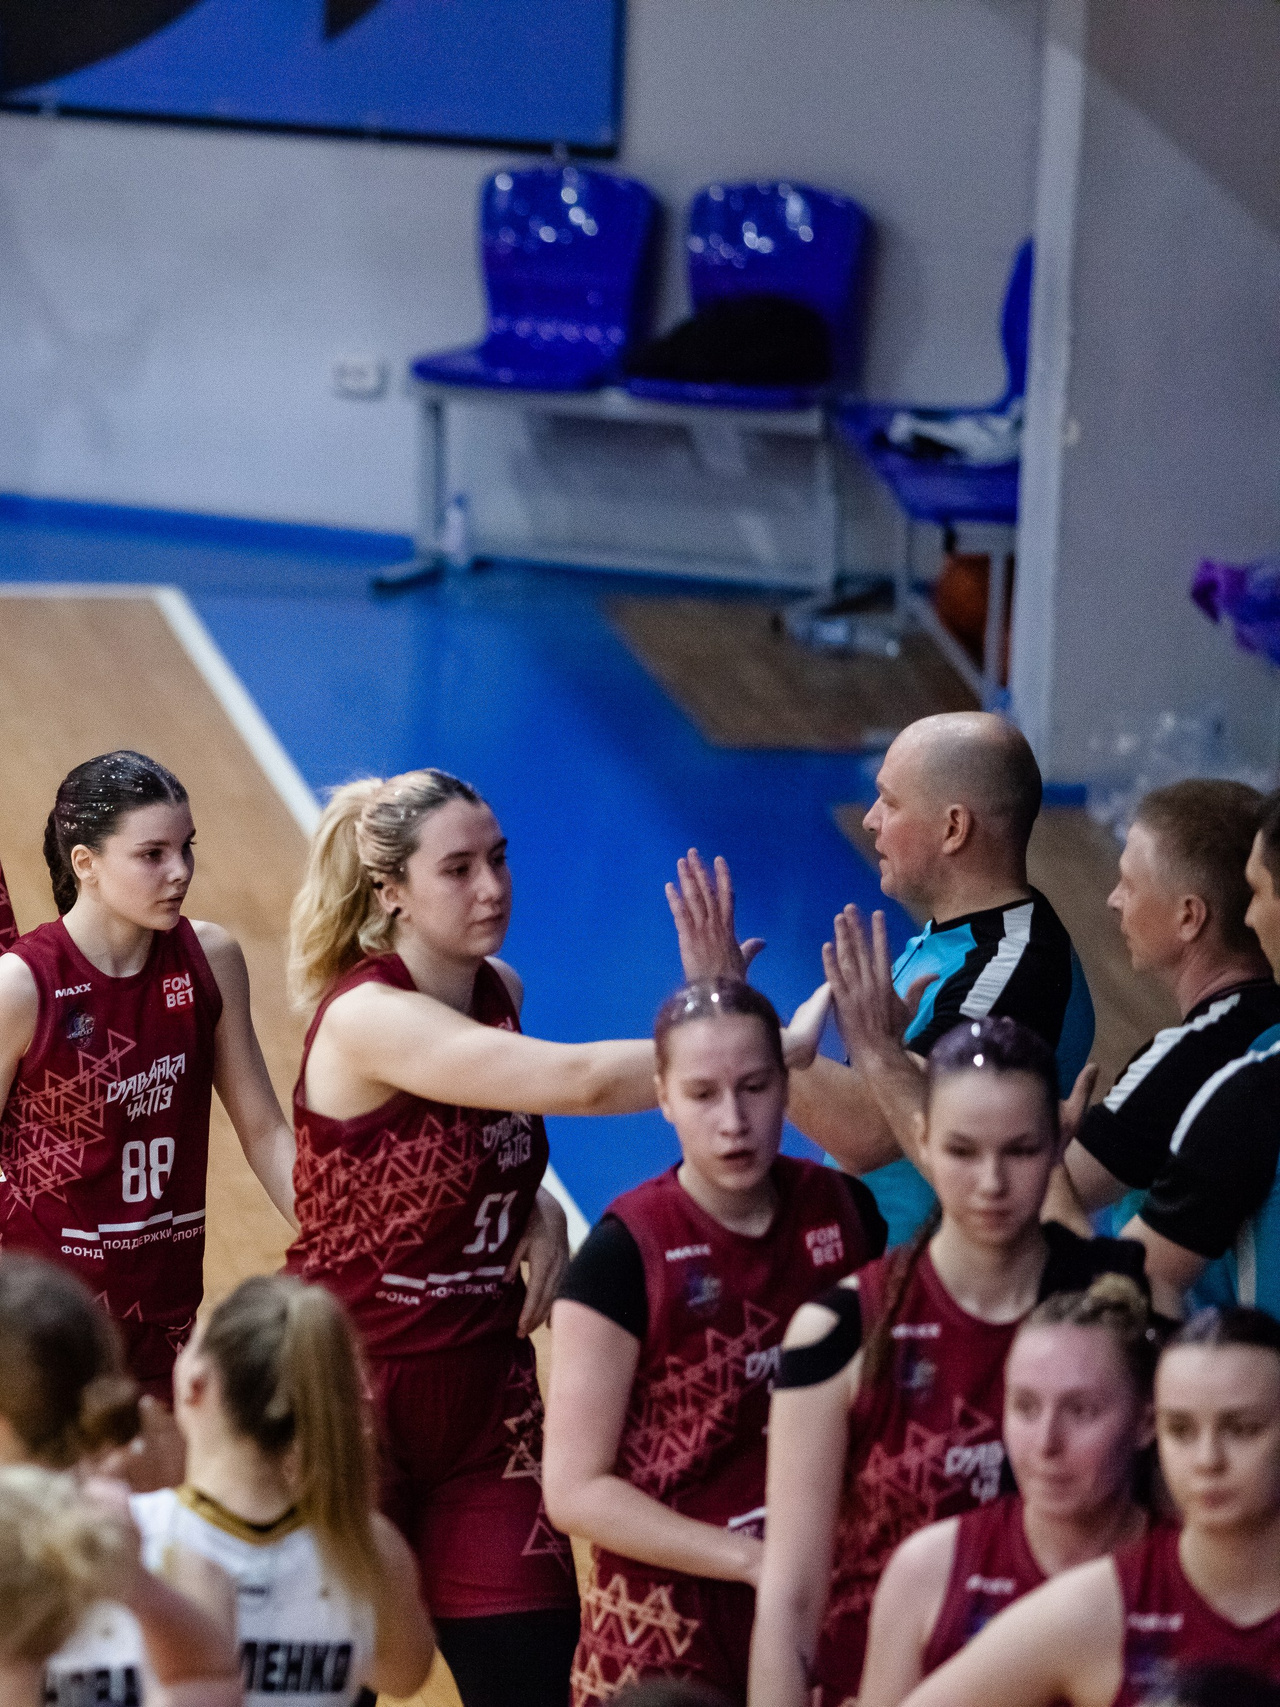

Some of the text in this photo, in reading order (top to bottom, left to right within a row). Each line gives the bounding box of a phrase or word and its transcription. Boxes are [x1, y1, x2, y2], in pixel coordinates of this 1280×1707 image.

[55, 982, 92, 998] MAXX
[163, 973, 191, 992] FON
[166, 987, 194, 1008] BET
[462, 1190, 518, 1254] 51
[61, 1244, 104, 1260] ФОНД
[103, 1227, 173, 1250] ПОДДЕРЖКИ
